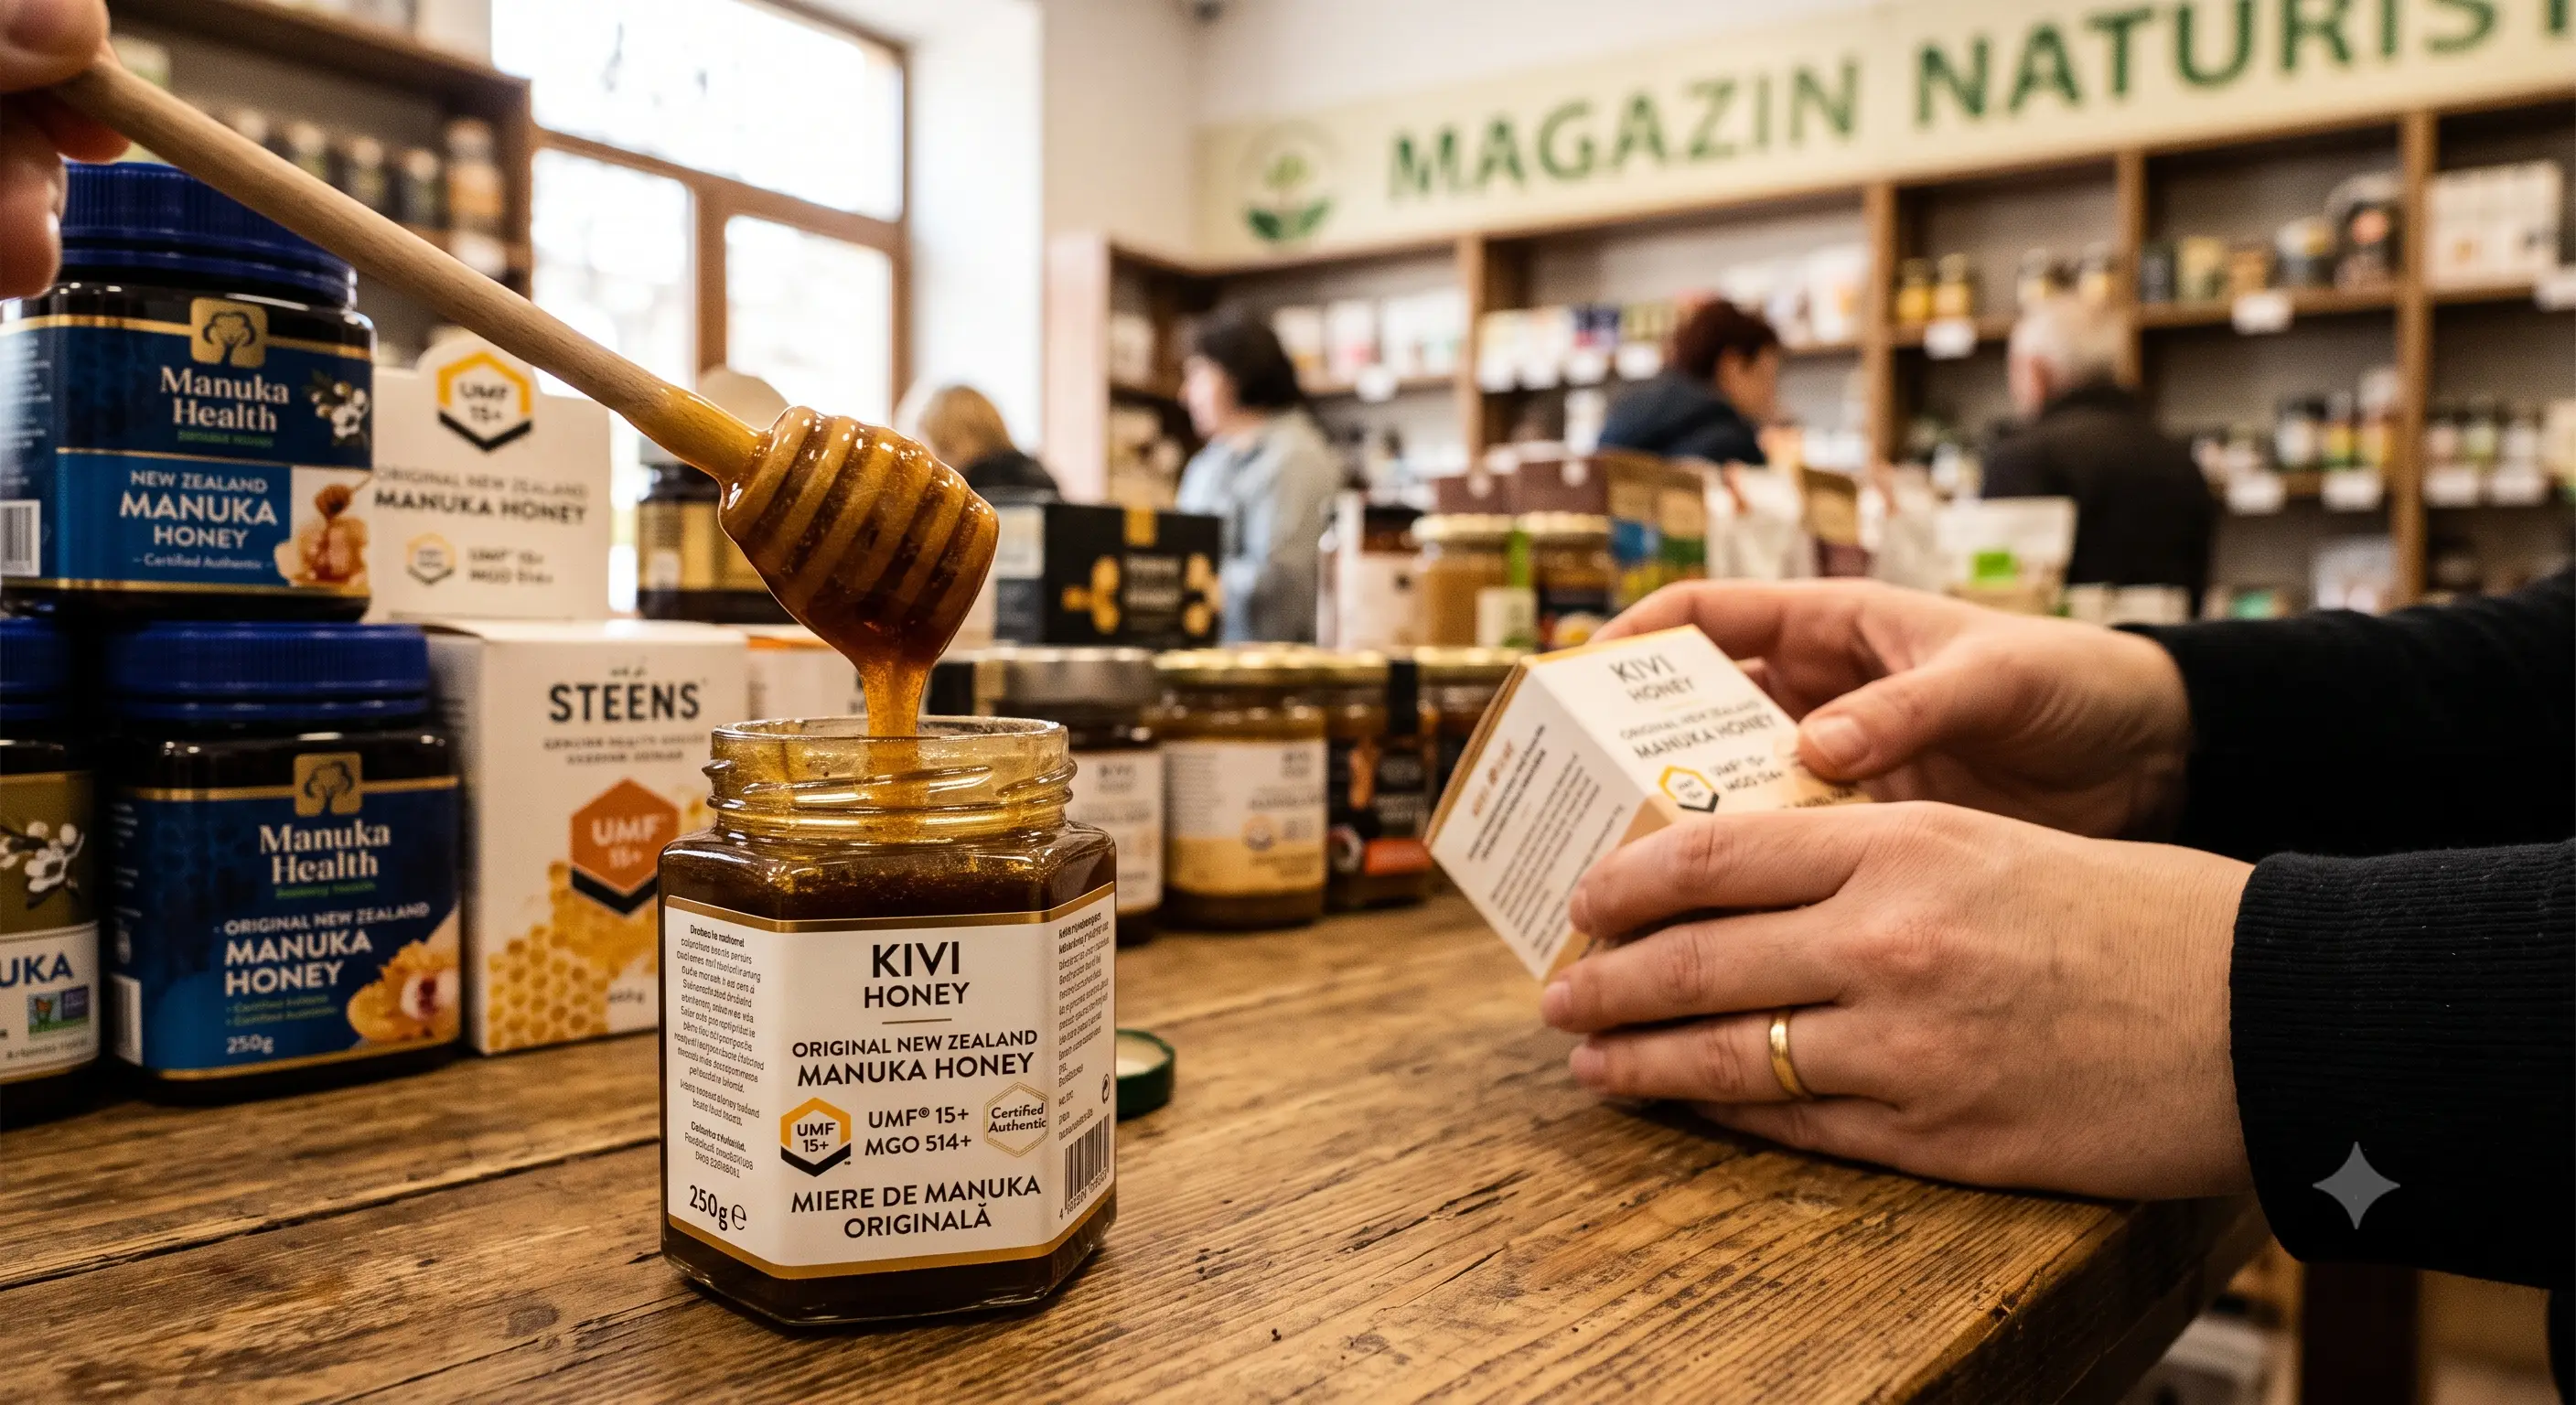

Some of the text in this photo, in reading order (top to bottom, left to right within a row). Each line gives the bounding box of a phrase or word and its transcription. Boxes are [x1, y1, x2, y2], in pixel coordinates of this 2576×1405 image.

[1389, 55, 1860, 203] MAGAZIN
[160, 366, 289, 404] Manuka
[172, 397, 277, 432] Health
[131, 469, 269, 495] NEW ZEALAND
[119, 489, 278, 527] MANUKA
[374, 488, 587, 524] MANUKA HONEY
[153, 525, 249, 550] HONEY
[1609, 654, 1677, 683] KIVI
[549, 681, 701, 724] STEENS
[1627, 676, 1694, 702] HONEY
[1633, 713, 1776, 760] MANUKA HONEY
[259, 818, 392, 854] Manuka
[272, 850, 379, 885] Health
[224, 901, 430, 937] ORIGINAL NEW ZEALAND
[224, 928, 373, 967] MANUKA
[872, 941, 960, 978] KIVI
[225, 960, 344, 997] HONEY
[864, 981, 970, 1009] HONEY
[226, 1034, 274, 1055] 250g
[792, 1029, 1037, 1057] ORIGINAL NEW ZEALAND
[798, 1052, 1035, 1087] MANUKA HONEY
[935, 1106, 970, 1125] 15+
[988, 1117, 1046, 1133] Authentic
[991, 1102, 1045, 1120] Certified
[797, 1121, 836, 1137] UMF
[803, 1138, 830, 1153] 15+
[864, 1132, 972, 1156] MGO 514+
[689, 1185, 728, 1231] 250g
[791, 1187, 875, 1213] MIERE
[883, 1185, 918, 1207] DE
[924, 1174, 1042, 1204] MANUKA
[843, 1202, 992, 1239] ORIGINALĂ
